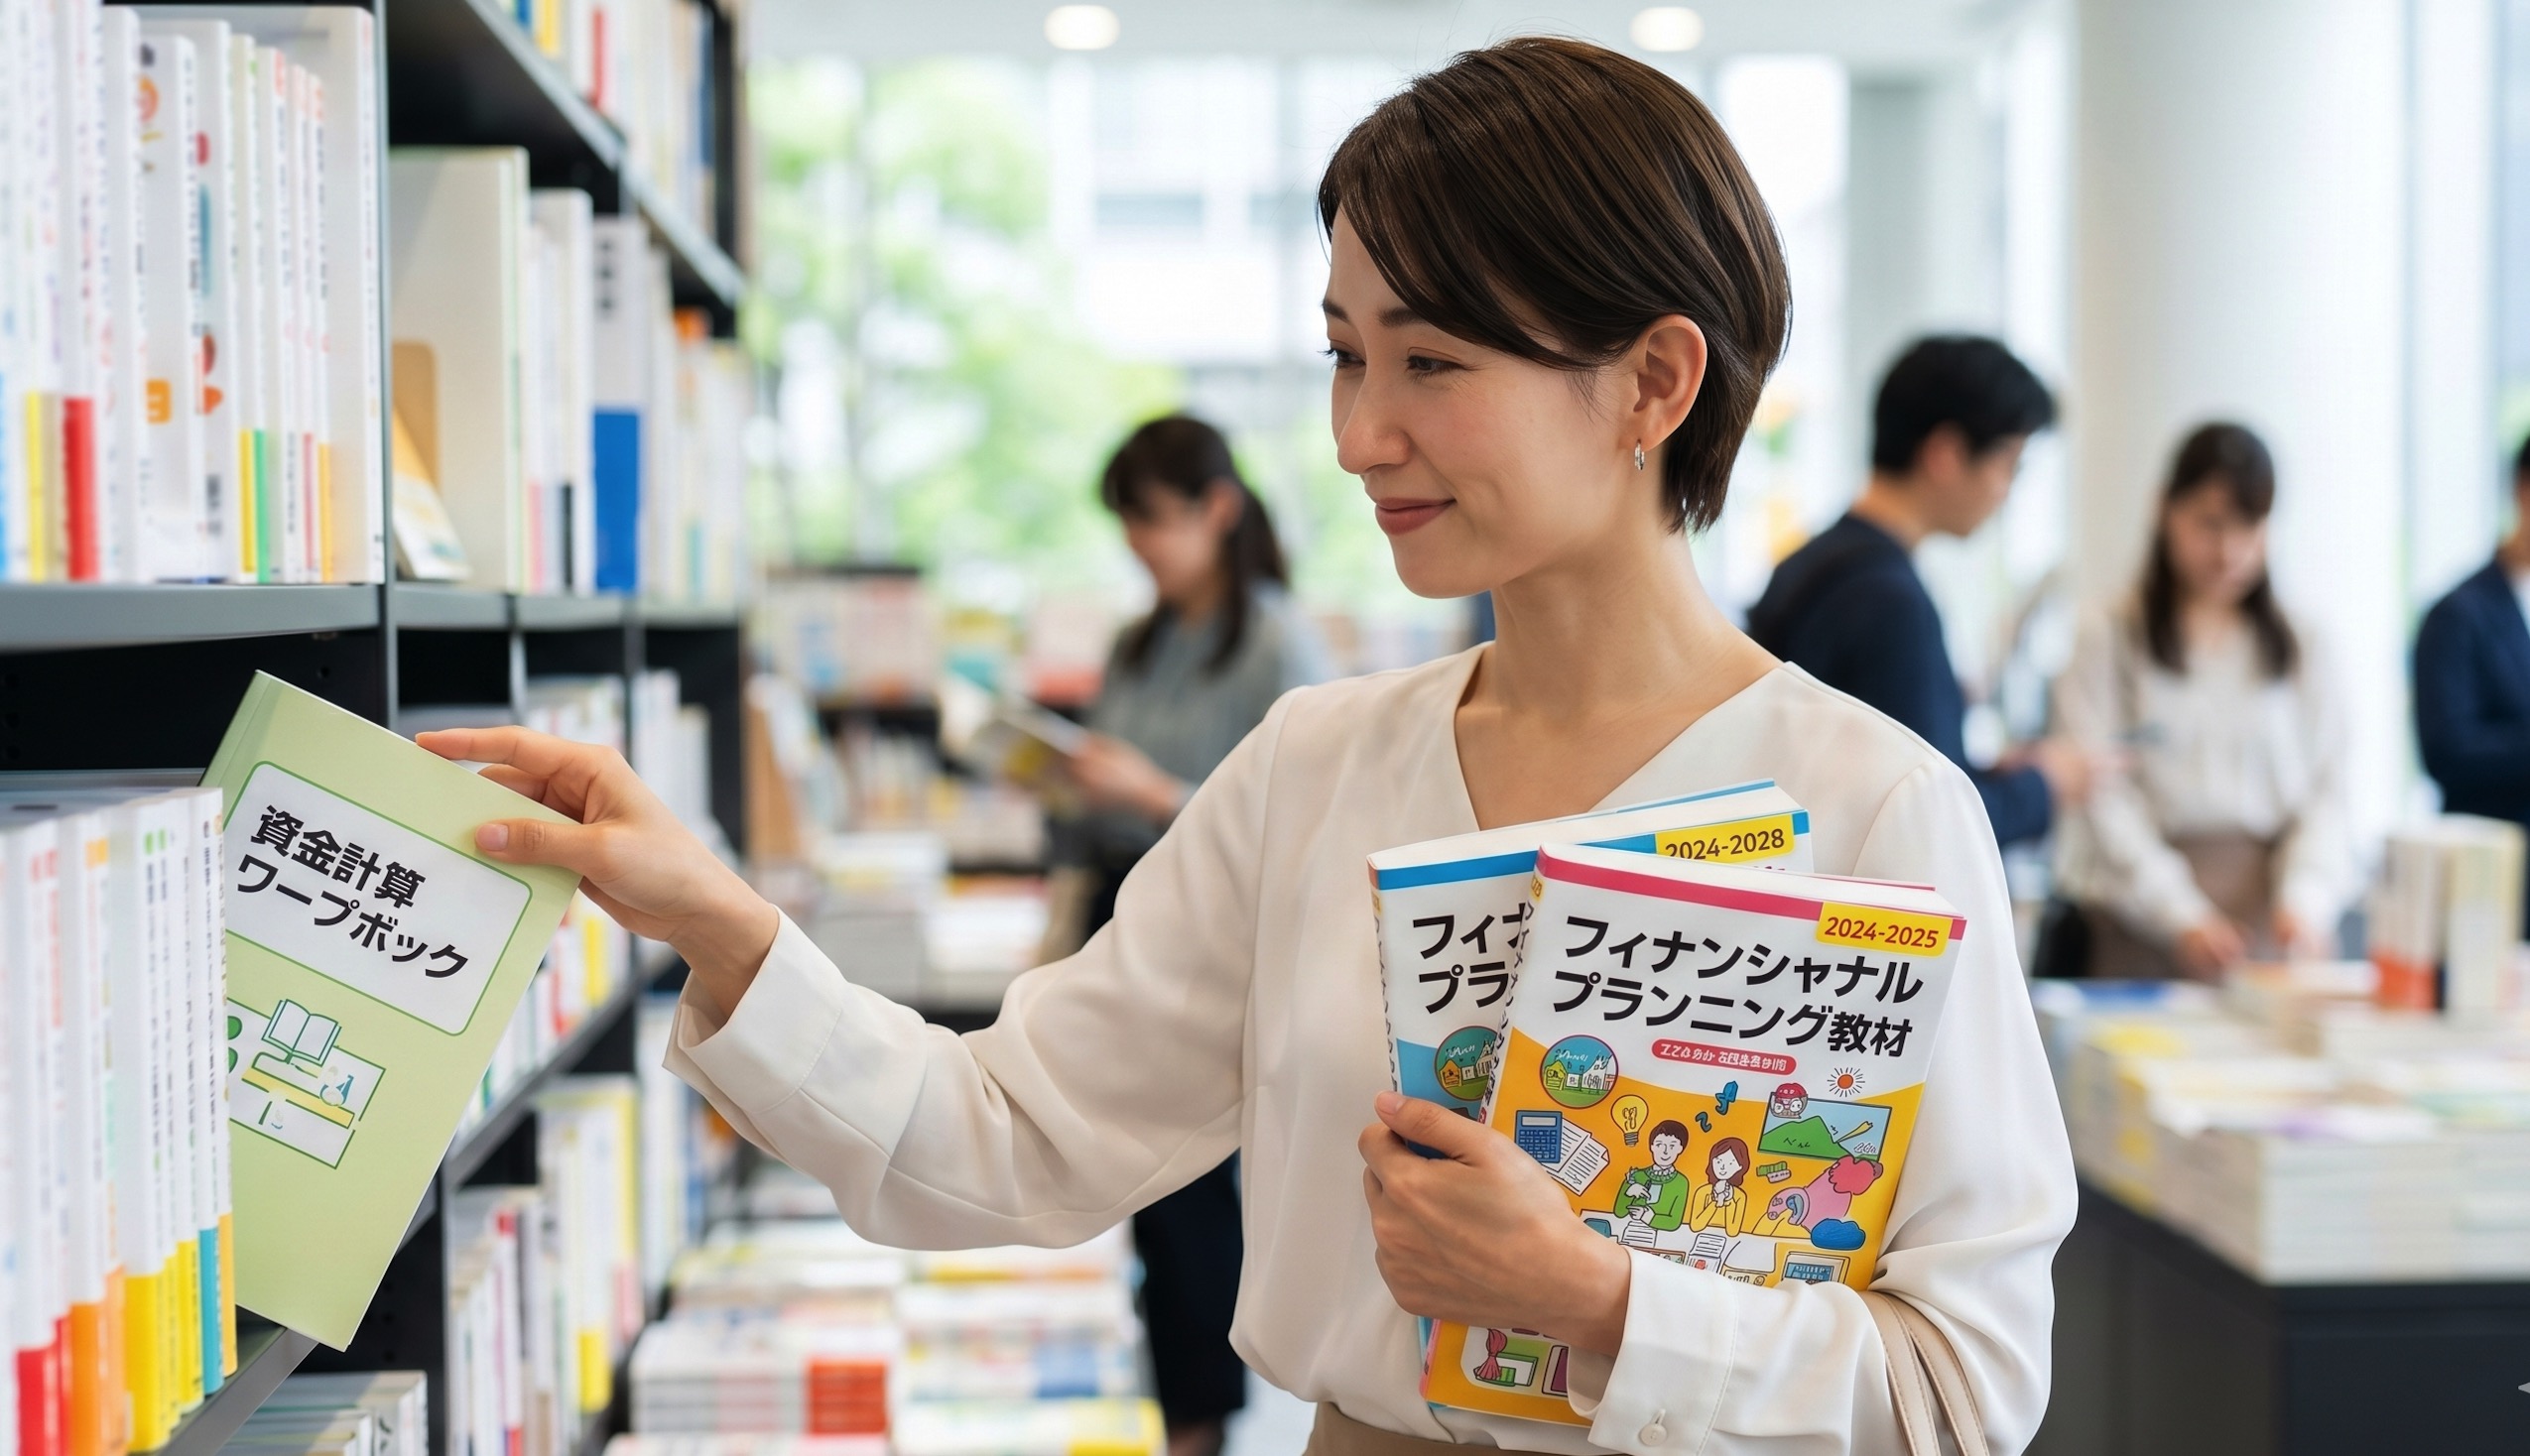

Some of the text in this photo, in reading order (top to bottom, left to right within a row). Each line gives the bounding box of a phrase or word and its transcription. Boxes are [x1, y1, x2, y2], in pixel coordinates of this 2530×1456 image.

[250, 804, 427, 910] 資金計算
[1665, 827, 1786, 861] 2024-2028
[237, 853, 469, 979] ワープボック
[1565, 914, 1925, 1005] フィナンシャナル
[1824, 915, 1940, 950] 2024-2025
[1418, 960, 1510, 1015] プラ
[1553, 969, 1914, 1058] プランニング教材
